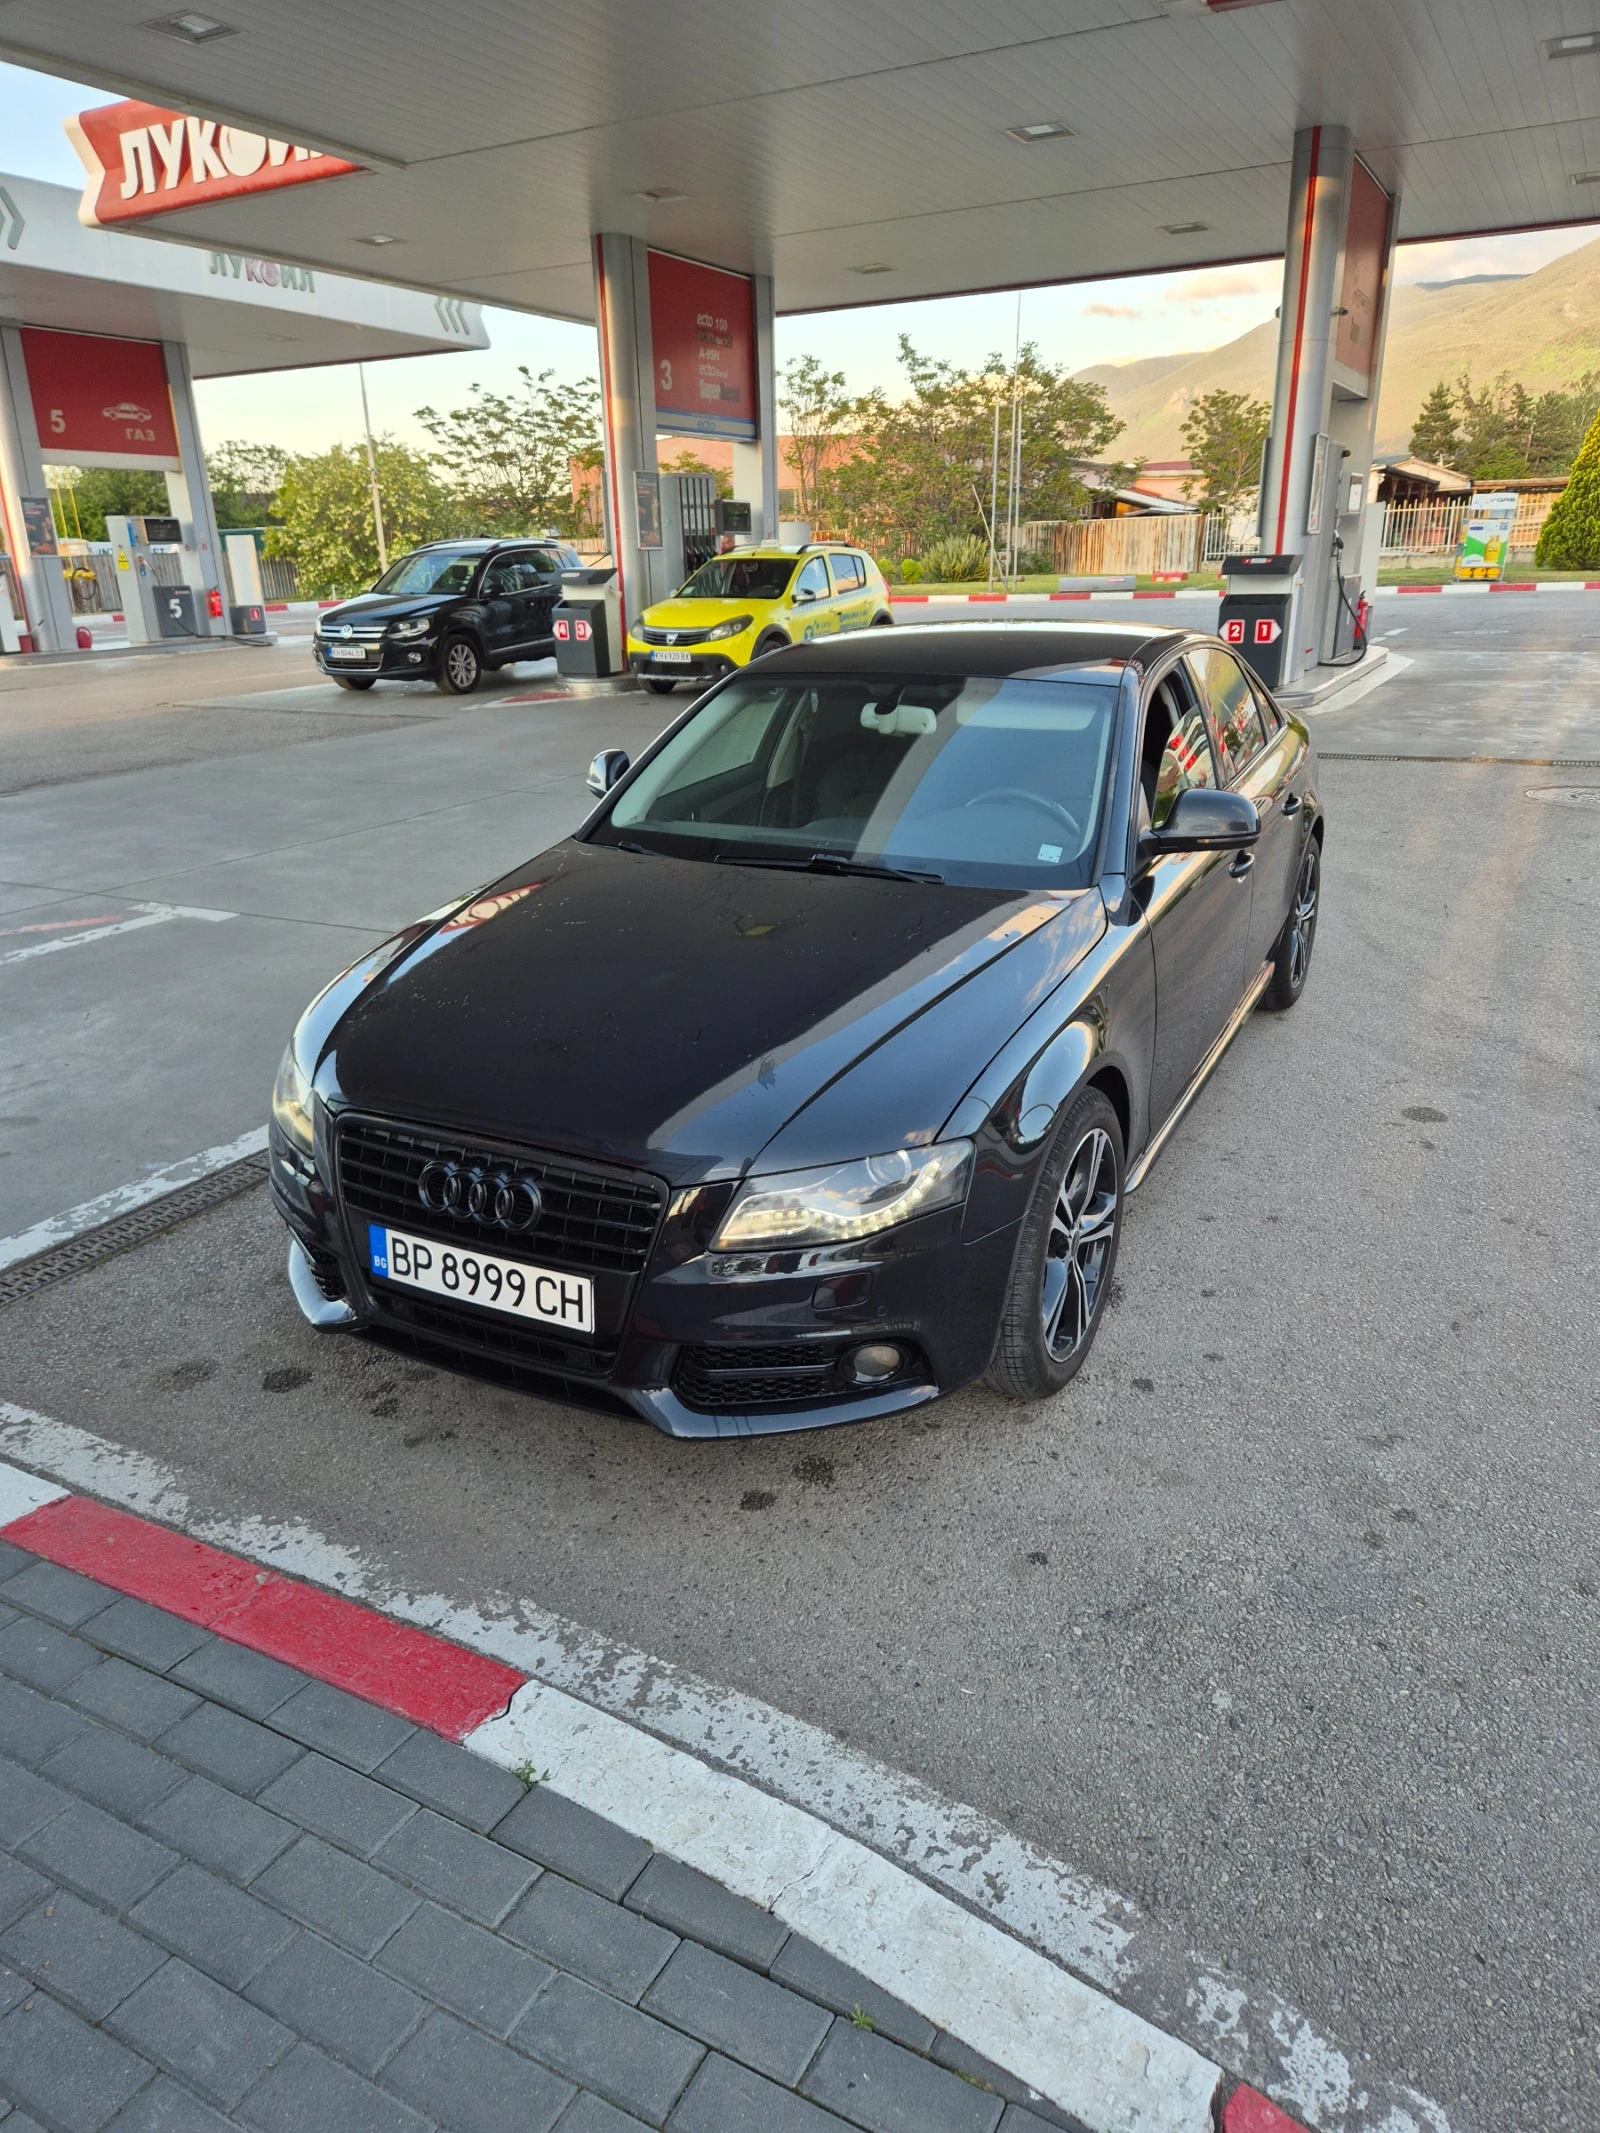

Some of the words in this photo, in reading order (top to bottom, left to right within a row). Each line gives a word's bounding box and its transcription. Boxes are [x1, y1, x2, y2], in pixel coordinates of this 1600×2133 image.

[660, 358, 673, 391] 3
[50, 409, 66, 434] 5
[125, 428, 156, 442] ГАЗ
[169, 598, 183, 619] 5
[559, 623, 567, 636] 4
[578, 623, 585, 636] 3
[1230, 624, 1241, 637] 2
[1261, 624, 1268, 637] 1
[374, 1255, 387, 1269] BG
[391, 1236, 433, 1281] BP
[441, 1252, 526, 1307] 8999
[535, 1276, 584, 1324] CH
